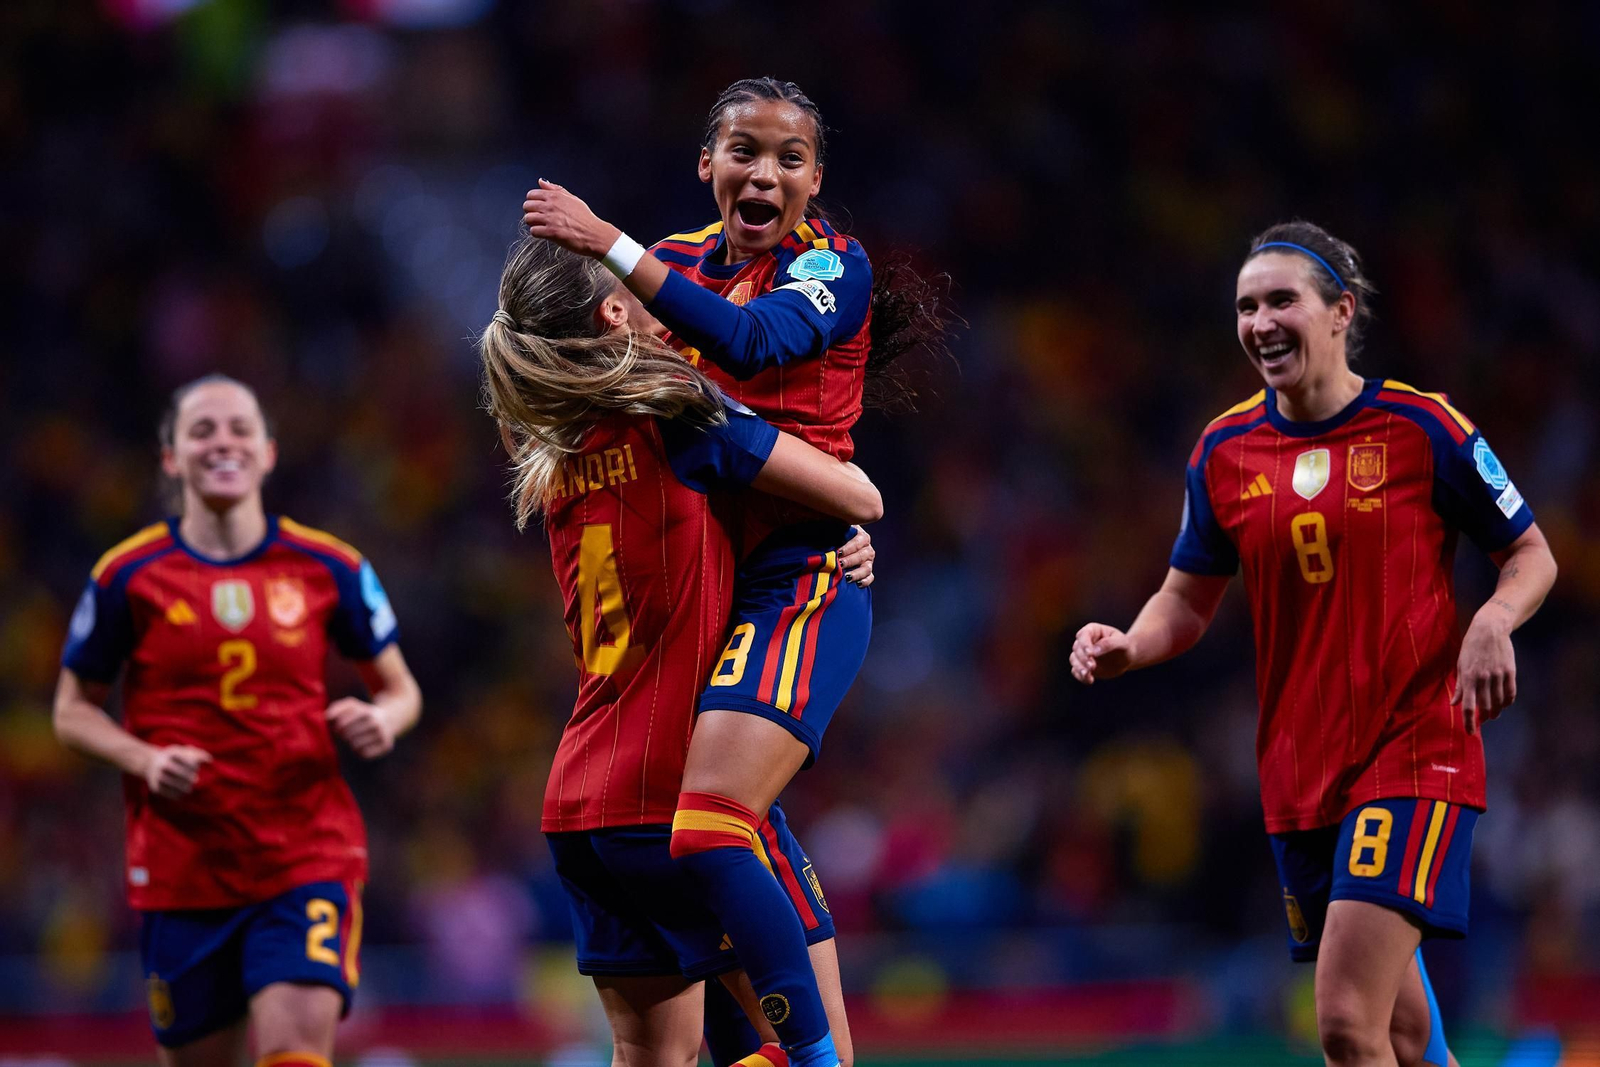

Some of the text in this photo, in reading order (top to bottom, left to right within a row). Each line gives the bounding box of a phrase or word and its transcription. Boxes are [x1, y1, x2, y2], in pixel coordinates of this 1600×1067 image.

[542, 444, 638, 503] ANDRI
[1291, 512, 1334, 584] 8
[577, 523, 647, 677] 4
[218, 639, 258, 711] 2
[709, 622, 757, 688] 8
[1348, 807, 1393, 878] 8
[305, 899, 340, 966] 2
